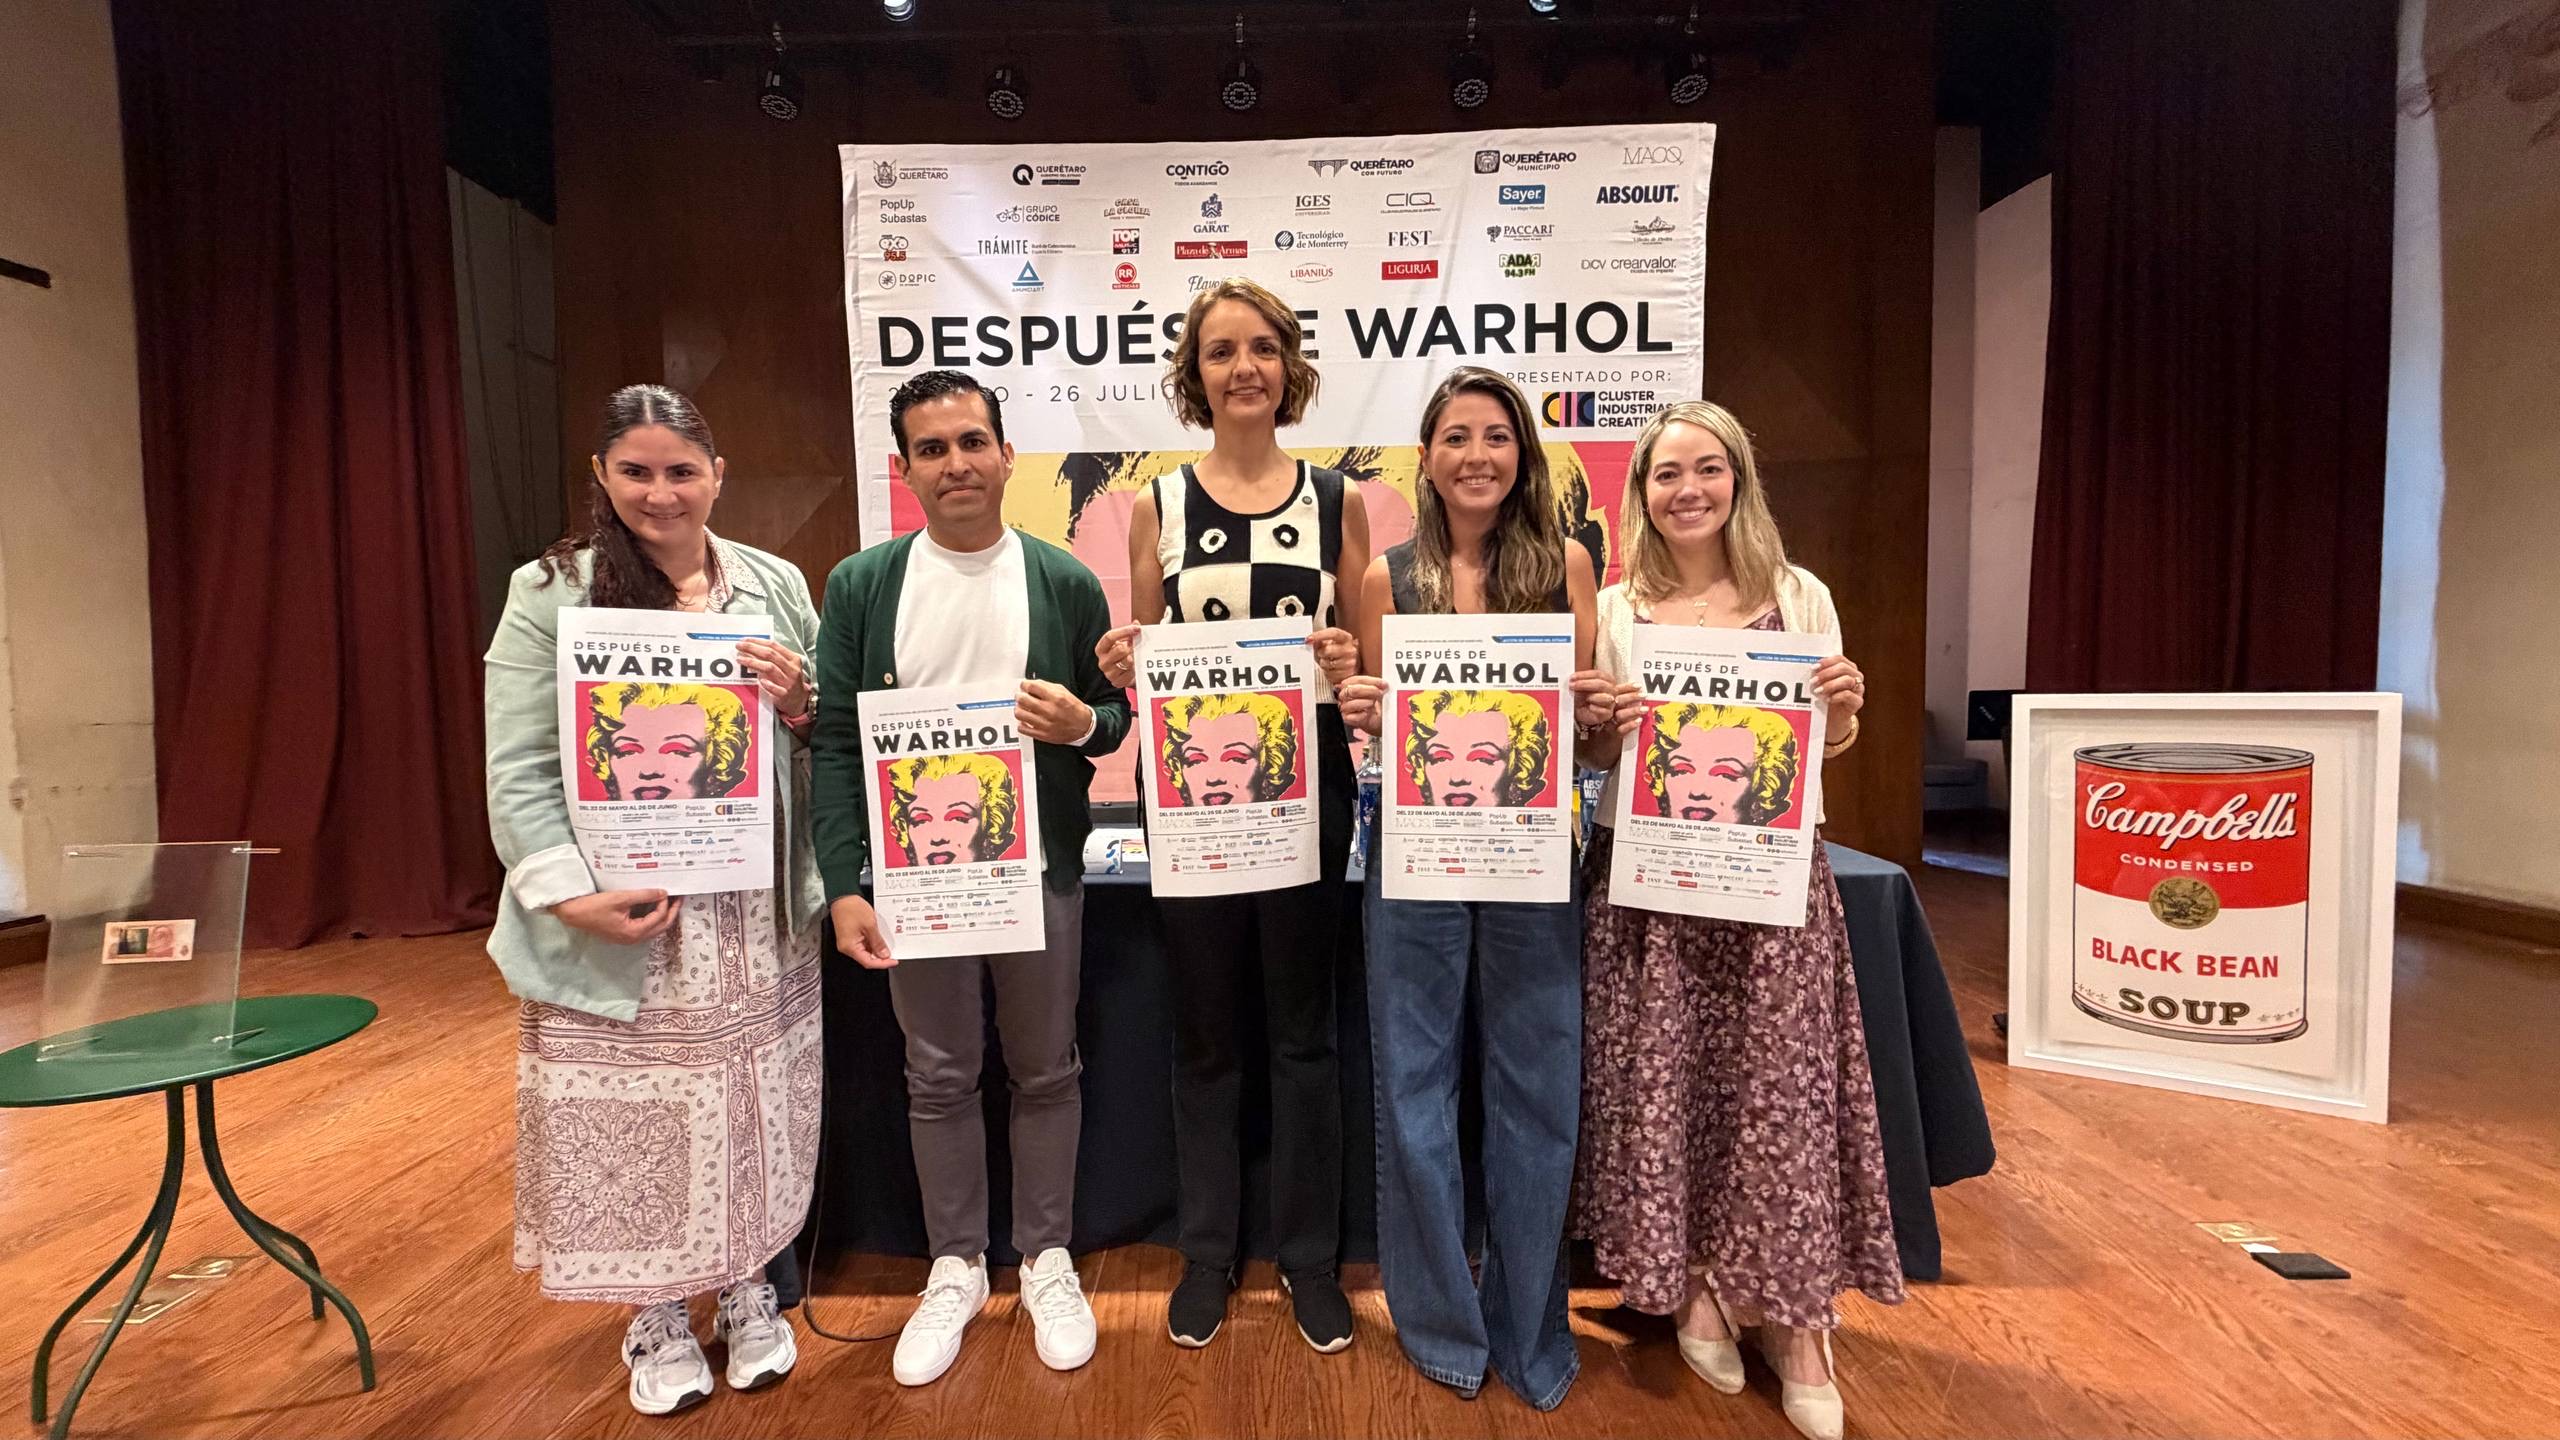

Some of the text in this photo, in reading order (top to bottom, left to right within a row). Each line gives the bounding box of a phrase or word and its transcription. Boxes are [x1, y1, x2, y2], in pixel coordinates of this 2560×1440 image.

[1350, 158, 1415, 172] QUERÉTARO
[1502, 150, 1577, 167] QUERÉTARO
[899, 169, 949, 180] QUERÉTARO
[1036, 164, 1087, 174] QUERÉTARO
[1166, 160, 1230, 180] CONTIGO
[1517, 164, 1560, 172] MUNICIPIO
[1295, 194, 1331, 208] IGES
[1502, 188, 1542, 202] Sayer
[880, 199, 915, 211] PopUp
[880, 214, 927, 223] Subastas
[1026, 213, 1060, 222] CÓDICE
[1193, 224, 1230, 233] GARAT
[1504, 224, 1552, 236] PACCARI
[1114, 230, 1139, 242] TOP
[1296, 230, 1344, 241] Tecnológico
[1388, 230, 1433, 246] FEST
[978, 235, 1028, 255] TRÁMITE
[1176, 244, 1247, 256] Plaza de Armas
[1296, 238, 1349, 250] de Monterrey
[1120, 268, 1134, 278] RR
[1290, 268, 1334, 279] LIBANIUS
[1388, 263, 1432, 275] LIGURIA
[1504, 268, 1536, 278] 94.3 FM
[1345, 301, 1673, 358] WARHOL
[1506, 370, 1671, 383] PRESENTADO POR:
[1050, 385, 1080, 402] 26
[1598, 390, 1654, 402] CLUSTER
[574, 640, 681, 654] DESPUÉS DE
[1396, 648, 1487, 660] DESPUÉS DE
[574, 654, 758, 679] WARHOL
[1146, 655, 1232, 668] DESPUÉS DE
[1643, 660, 1740, 675] DESPUÉS DE
[1147, 664, 1301, 692] WARHOL
[1396, 662, 1558, 684] WARHOL
[1643, 673, 1812, 704] WARHOL
[872, 718, 954, 732] DESPUÉS DE
[872, 725, 1020, 754] WARHOL
[2119, 852, 2254, 873] CONDENSED
[2092, 937, 2279, 978] BLACK BEAN
[2118, 987, 2250, 1026] SOUP
